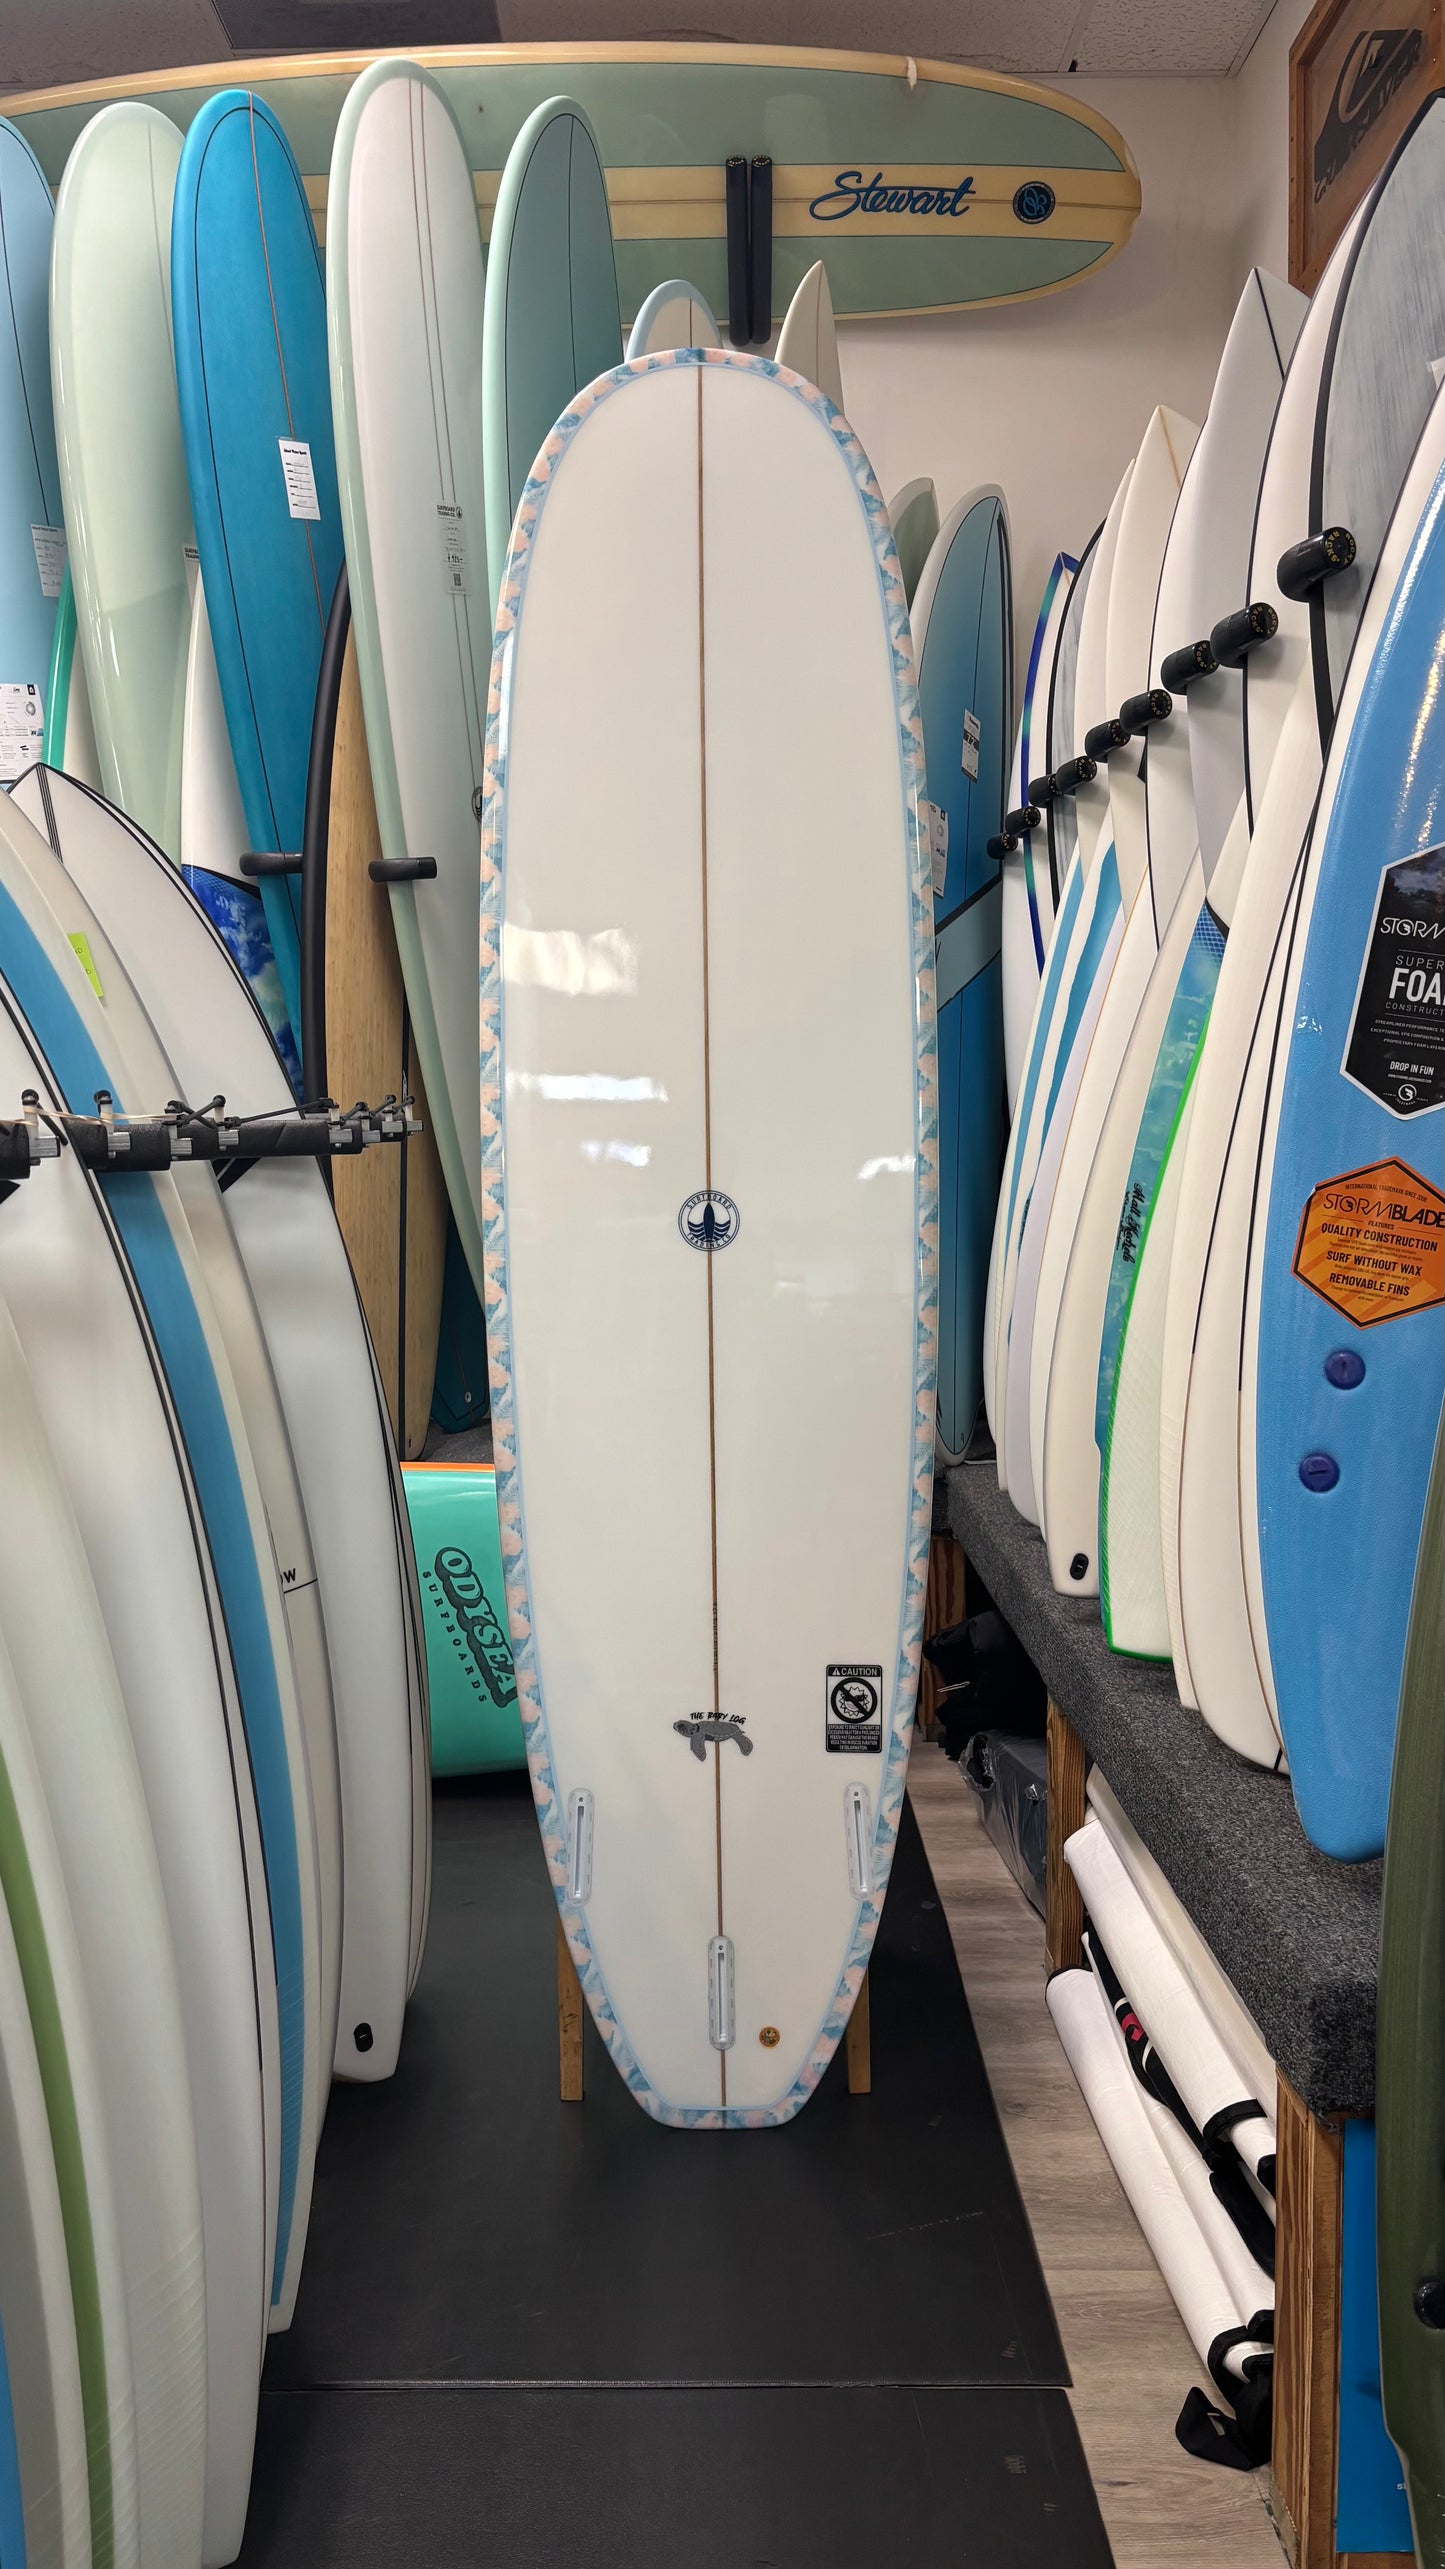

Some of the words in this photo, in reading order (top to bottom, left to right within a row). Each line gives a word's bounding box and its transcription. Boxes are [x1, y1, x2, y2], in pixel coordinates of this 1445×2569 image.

[809, 170, 977, 221] Stewart
[1396, 955, 1445, 971] SUPER
[1389, 967, 1445, 1006] FOA
[1390, 1061, 1409, 1072] DROP
[1410, 1064, 1418, 1073] IN
[1419, 1065, 1434, 1076] FUN
[1323, 1193, 1445, 1228] STORMBLADE
[1321, 1223, 1361, 1238] QUALITY
[1363, 1229, 1438, 1252] CONSTRUCTION
[1368, 1220, 1395, 1230] FEATURES
[1326, 1250, 1352, 1263] SURF
[1353, 1254, 1398, 1272] WITHOUT
[1400, 1262, 1423, 1277] WAX
[1329, 1272, 1386, 1292] REMOVABLE
[1387, 1283, 1410, 1297] FINS
[283, 1568, 296, 1583] W
[422, 1571, 487, 1702] SURFBOARDS
[841, 1667, 878, 1676] CAUTION
[690, 1712, 705, 1720] THE
[707, 1712, 728, 1720] BABY
[729, 1714, 747, 1725] LOG
